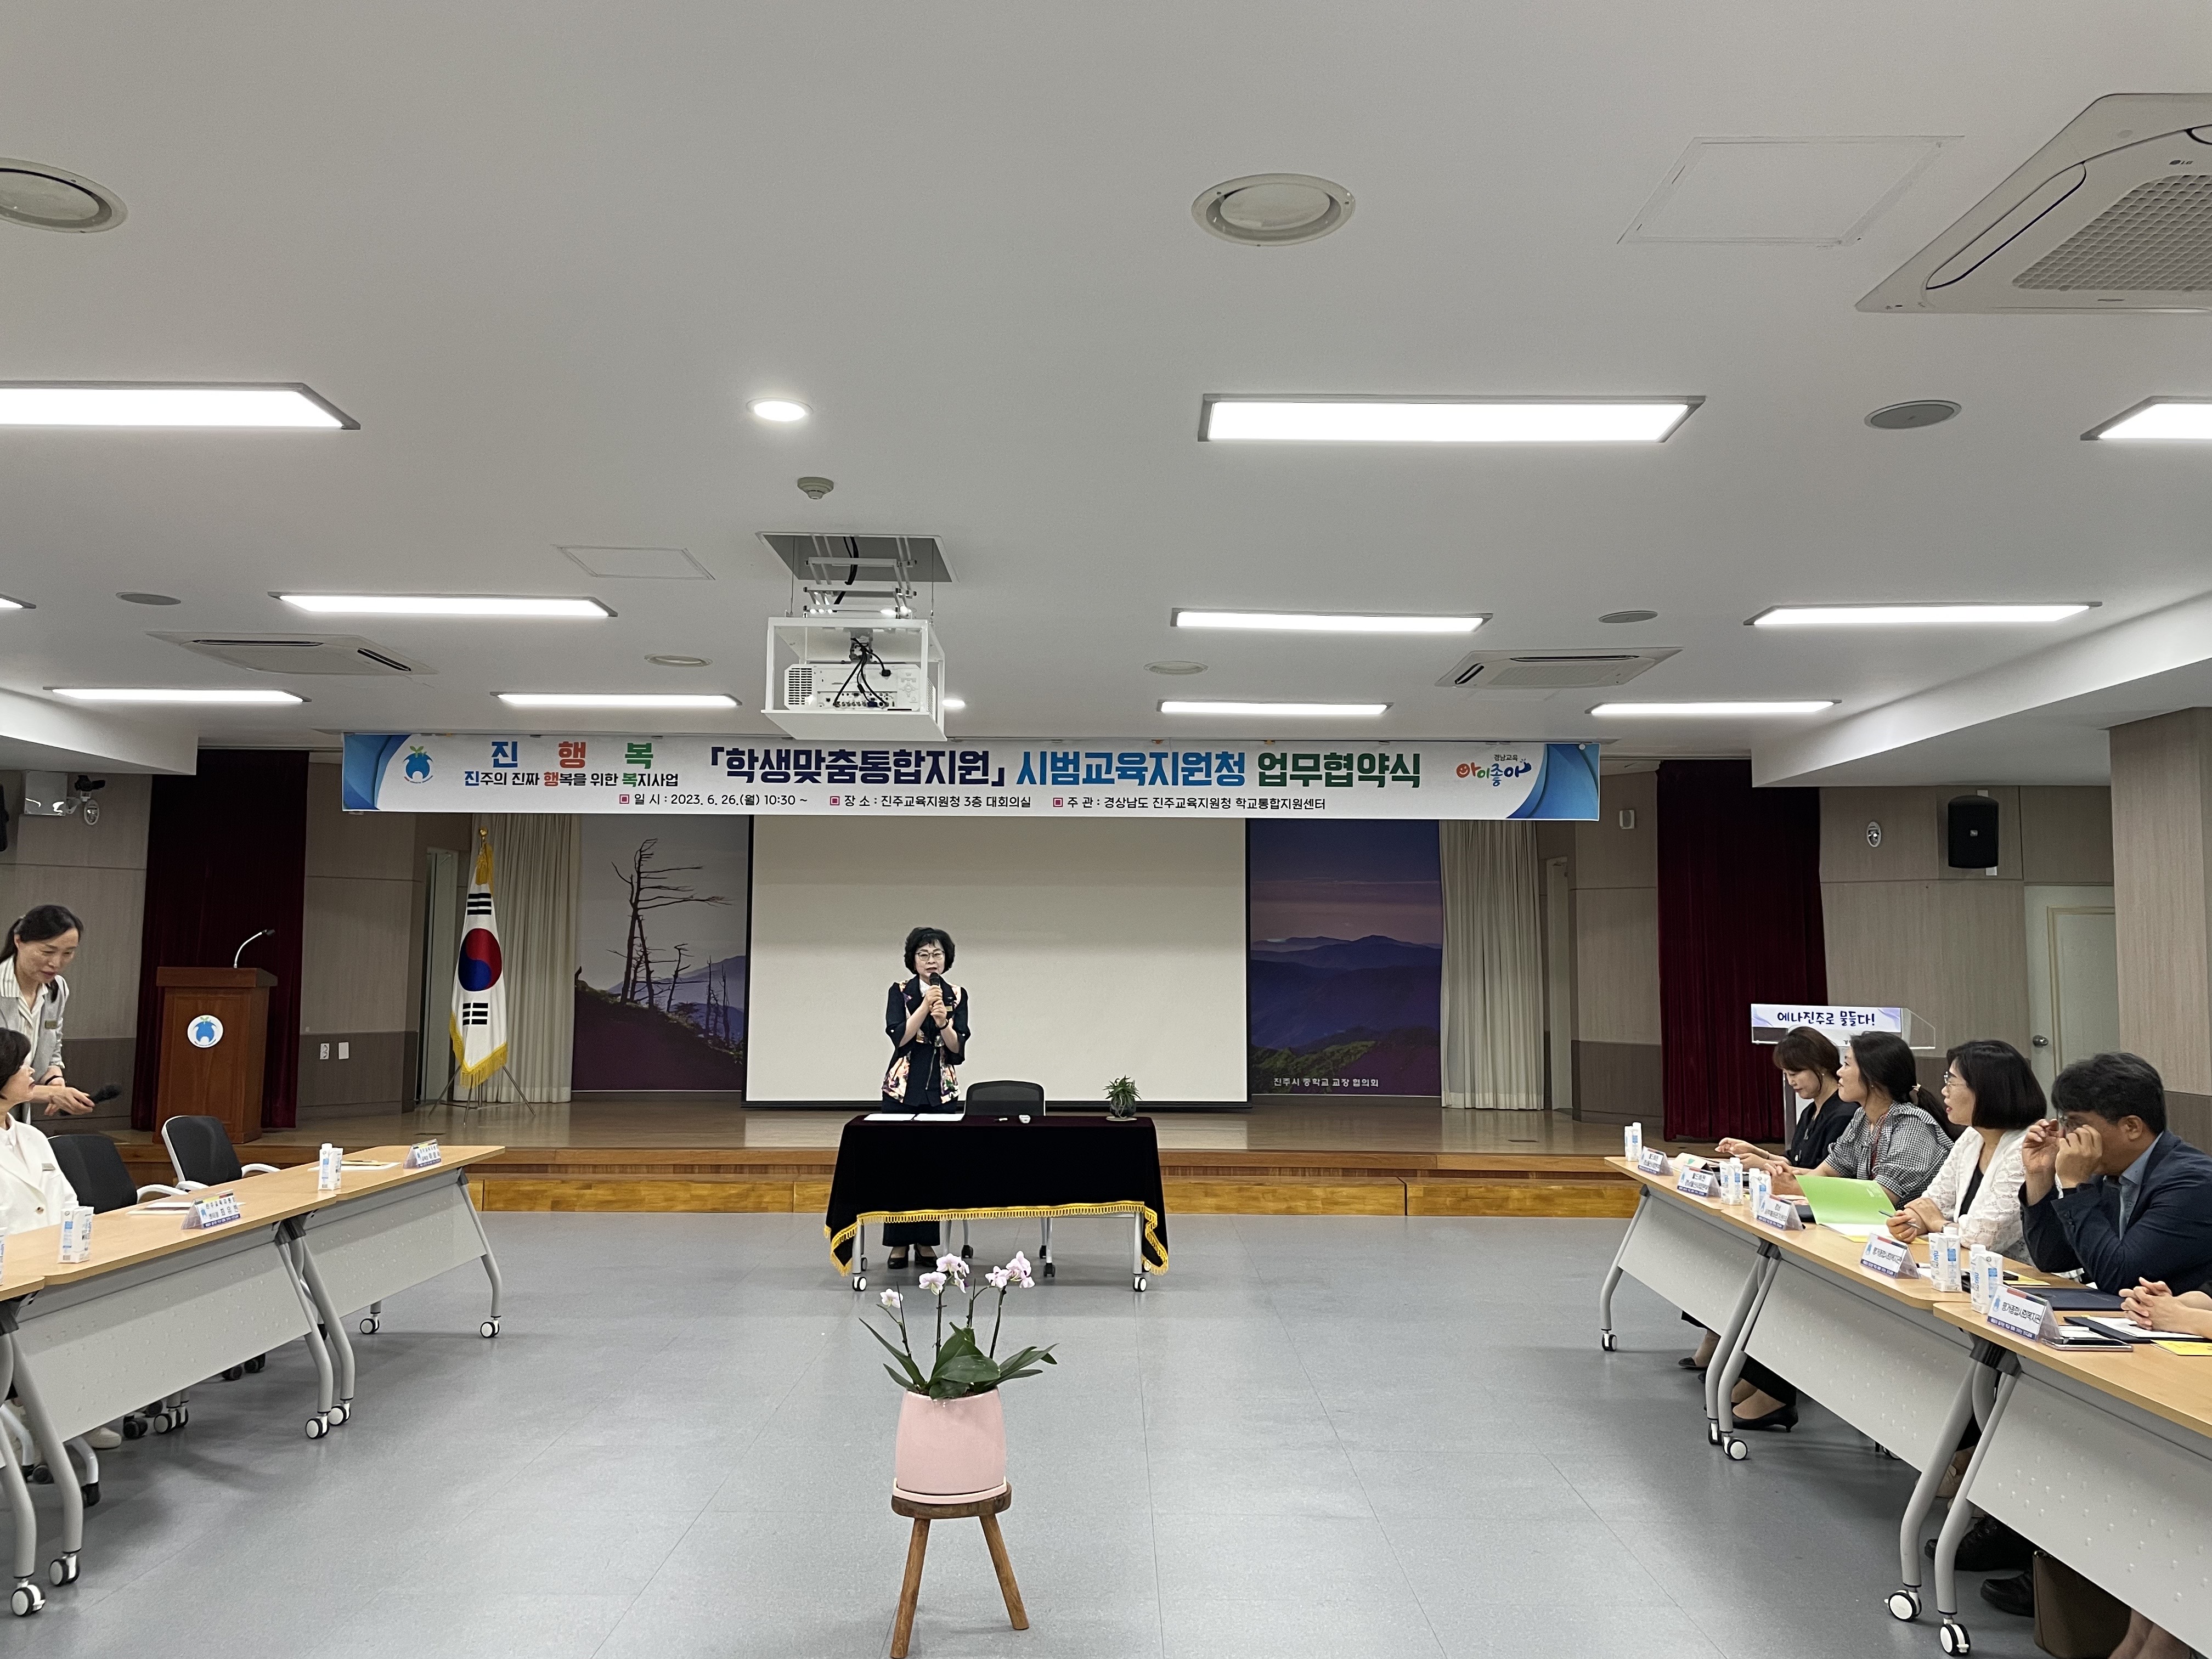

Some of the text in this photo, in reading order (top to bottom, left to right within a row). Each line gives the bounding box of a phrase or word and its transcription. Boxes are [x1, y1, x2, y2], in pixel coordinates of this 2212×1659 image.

[491, 741, 653, 769] 진 행 복
[1016, 751, 1245, 787] 시범교육지원청
[1258, 752, 1420, 788] 업무협약식
[1456, 761, 1532, 787] 아이좋아
[464, 771, 678, 787] 진주의 진짜 행복을 위한 복지사업
[671, 794, 703, 805] 2023.
[764, 795, 795, 805] 10:30
[881, 795, 960, 808] 진주교육지원청
[964, 795, 983, 808] 3층
[986, 796, 1031, 808] 대회의실
[1104, 797, 1149, 809] 경상남도
[1153, 797, 1231, 809] 진주교육지원청
[1235, 797, 1325, 810] 학교통합지원센터
[1777, 1011, 1875, 1027] 에나진주로 물들다!
[1274, 1077, 1379, 1087] 진주시 중학교 교장 협의회
